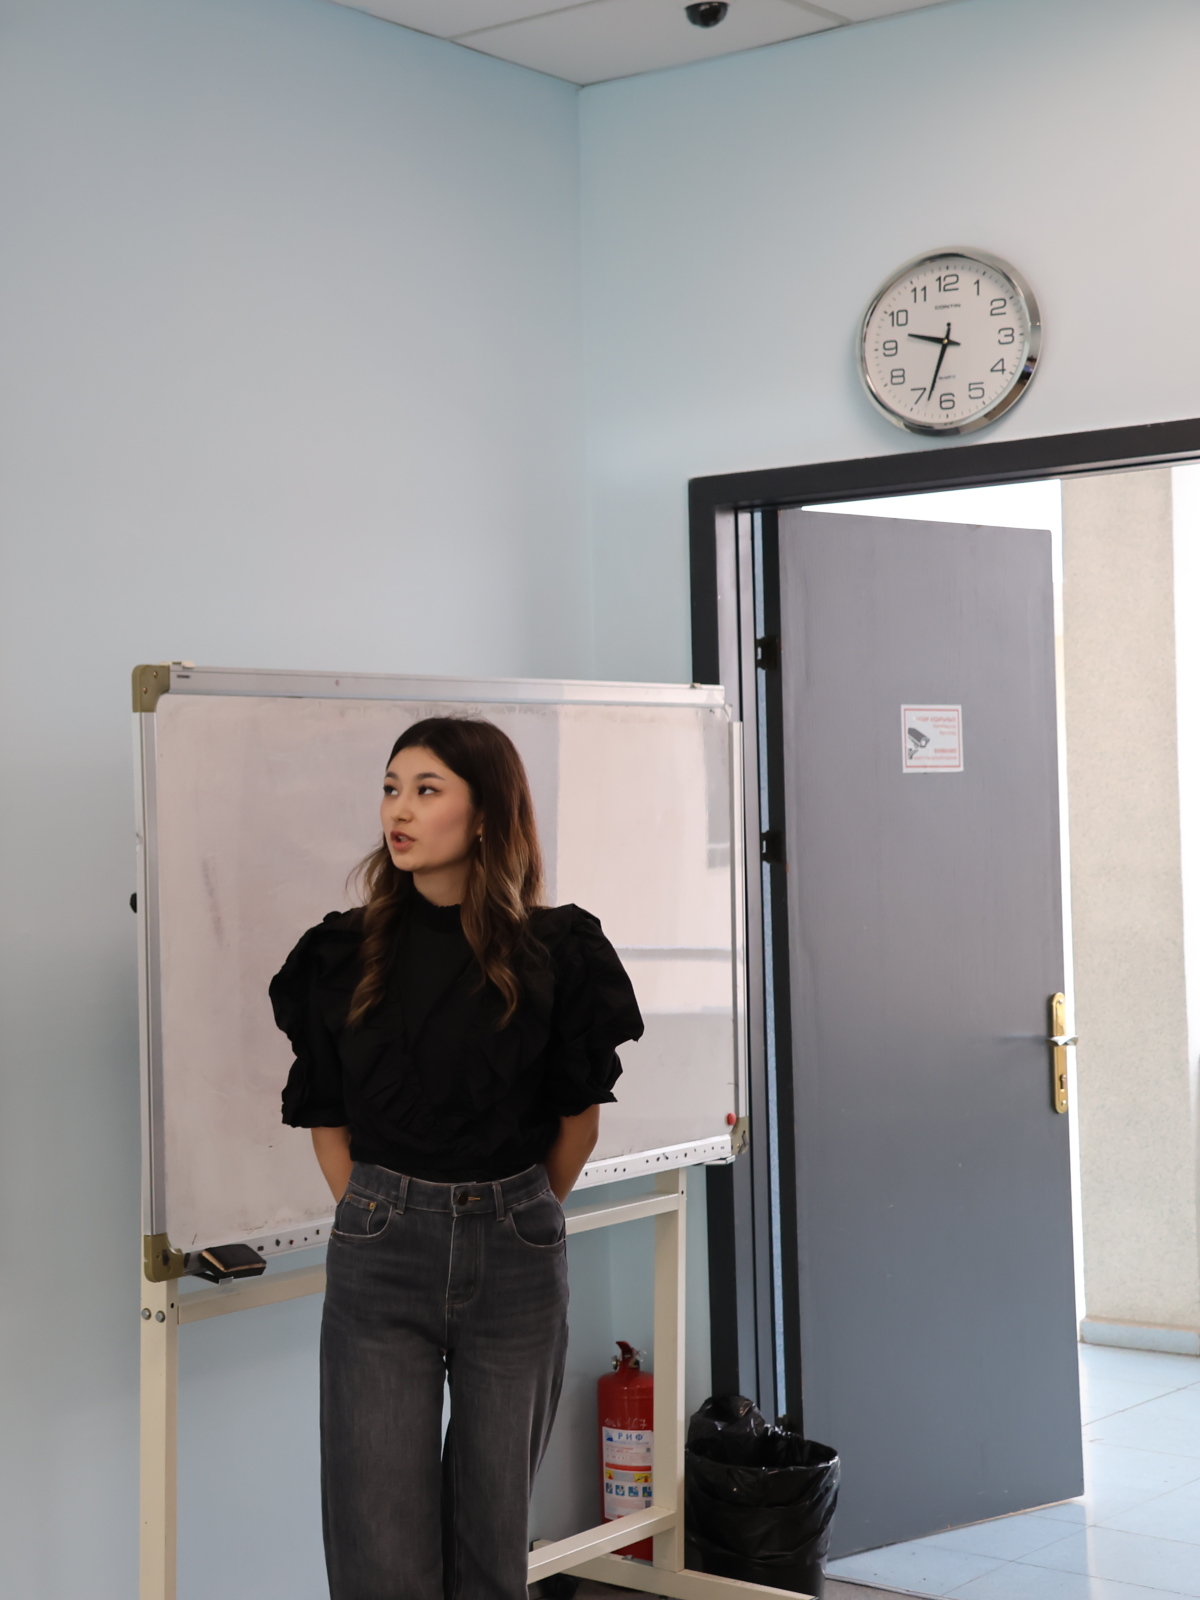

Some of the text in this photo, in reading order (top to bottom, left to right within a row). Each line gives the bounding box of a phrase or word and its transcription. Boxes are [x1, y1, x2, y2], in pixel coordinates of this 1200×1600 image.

[935, 273, 959, 293] 12
[973, 279, 980, 296] 1
[911, 285, 927, 303] 11
[990, 298, 1007, 316] 2
[888, 309, 909, 327] 10
[998, 327, 1015, 345] 3
[882, 340, 898, 357] 9
[990, 358, 1007, 375] 4
[890, 368, 905, 385] 8
[910, 387, 927, 405] 7
[968, 381, 985, 399] 5
[939, 392, 955, 410] 6
